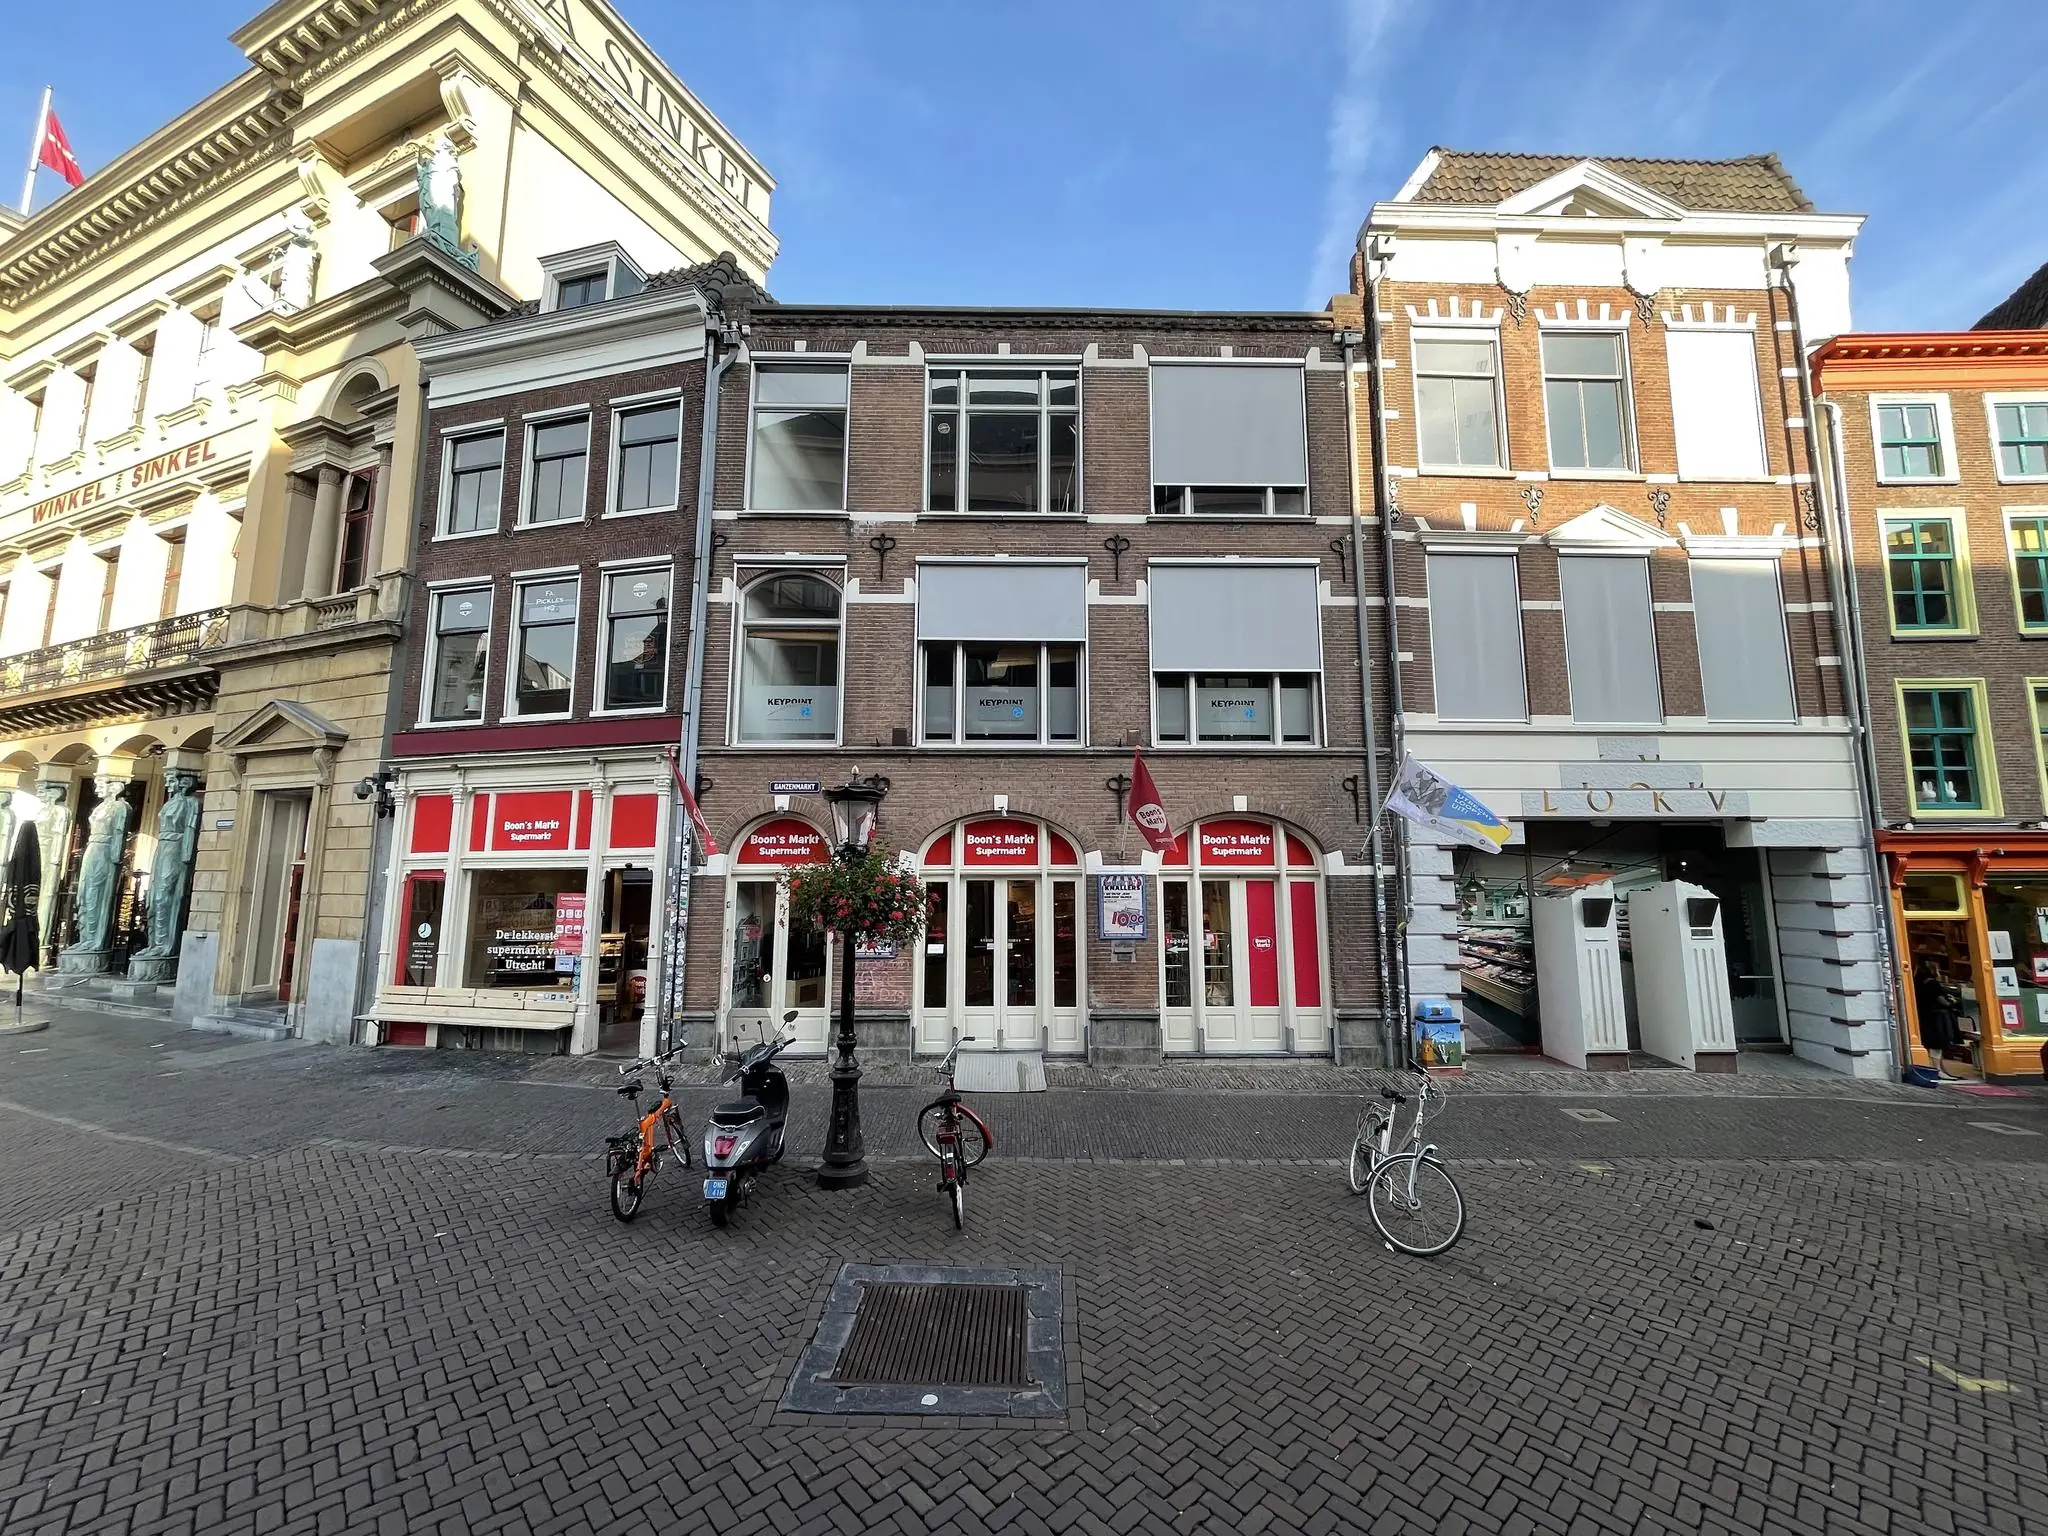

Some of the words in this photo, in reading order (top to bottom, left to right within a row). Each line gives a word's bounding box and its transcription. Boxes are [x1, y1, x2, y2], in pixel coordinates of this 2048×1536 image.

[33, 482, 106, 524] WINKEL
[132, 441, 217, 488] SINKEL
[536, 597, 565, 605] PICKLES
[767, 698, 813, 706] KEYPOINT
[979, 699, 1024, 707] KEYPOINT
[1211, 700, 1255, 708] KEYPOINT
[773, 783, 816, 791] GANZENMARKT
[1454, 798, 1481, 816] LOOPT
[1457, 793, 1493, 821] UTRECHT
[1139, 807, 1162, 820] Boon's
[504, 821, 532, 831] Boon's
[534, 820, 559, 830] Markt
[1145, 814, 1165, 827] Markt
[510, 832, 552, 842] Supermarkt
[750, 834, 785, 844] Boon's
[789, 834, 820, 844] Markt
[967, 834, 1001, 844] Boon's
[1004, 834, 1036, 844] Markt
[1202, 834, 1238, 845] Boon's
[1240, 834, 1271, 845] Markt
[759, 846, 811, 858] Supermarkt
[976, 846, 1026, 857] Supermarkt
[1211, 846, 1263, 857] Supermarkt
[496, 930, 510, 940] De
[512, 930, 559, 941] lekkerste
[487, 946, 546, 957] supermarkt
[548, 947, 566, 955] van
[505, 959, 545, 970] Utrecht!
